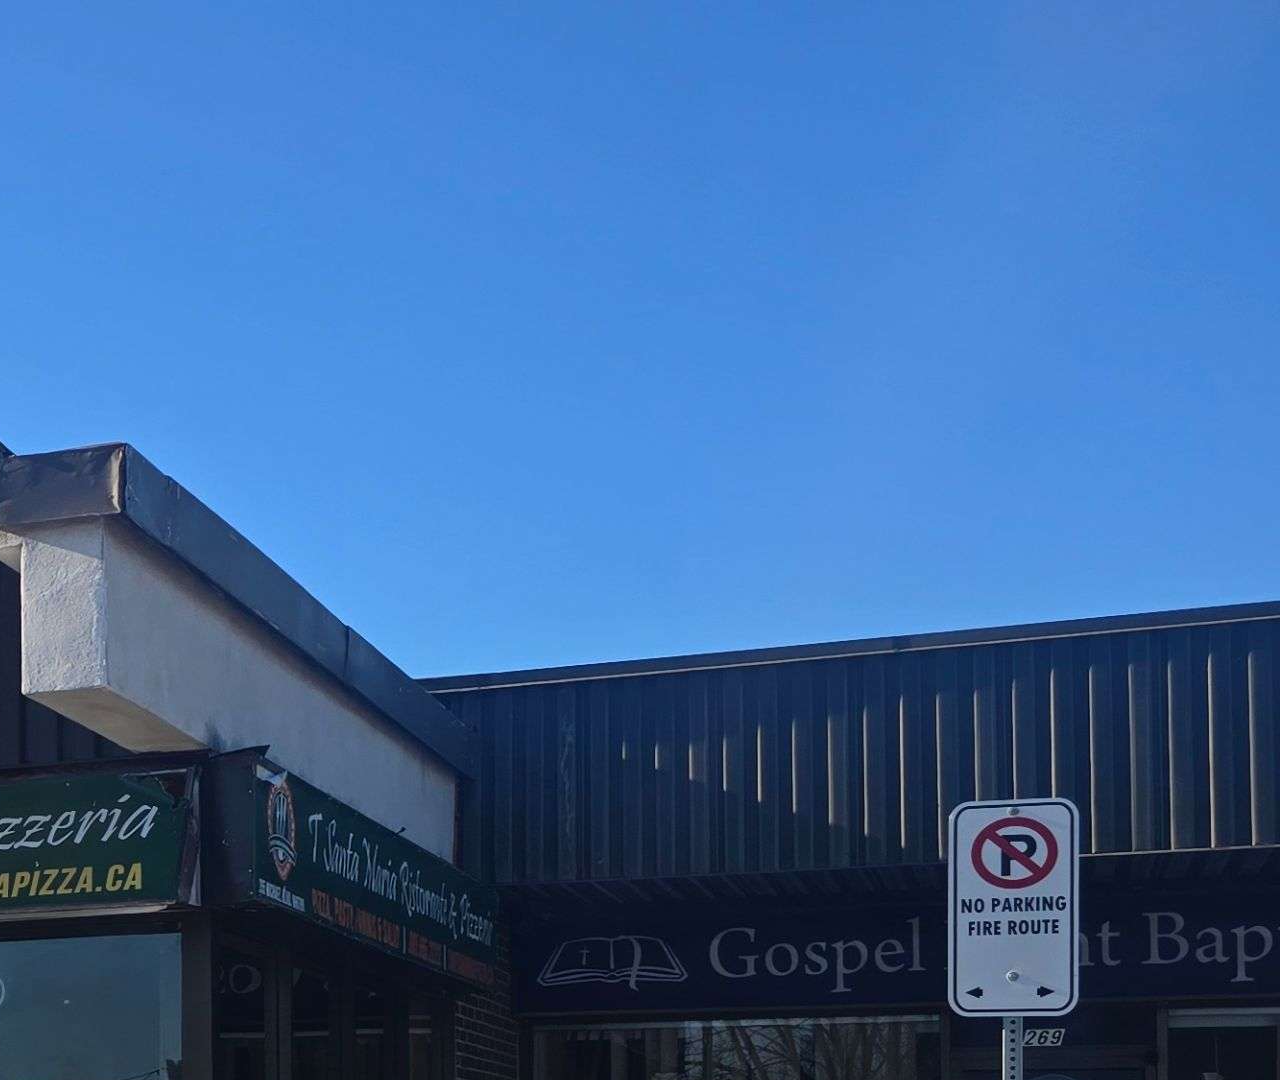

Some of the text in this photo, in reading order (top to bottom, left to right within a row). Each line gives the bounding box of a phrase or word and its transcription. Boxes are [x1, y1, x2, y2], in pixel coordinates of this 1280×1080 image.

[308, 813, 323, 863] T
[323, 819, 359, 881] Santa
[362, 838, 397, 902] Maria
[399, 861, 448, 925] Ristorante
[961, 896, 1067, 913] NO PARKING
[968, 919, 1060, 936] FIRE ROUTE
[709, 916, 927, 993] Gospel
[1142, 911, 1280, 982] Bap
[1024, 1030, 1062, 1046] 269
